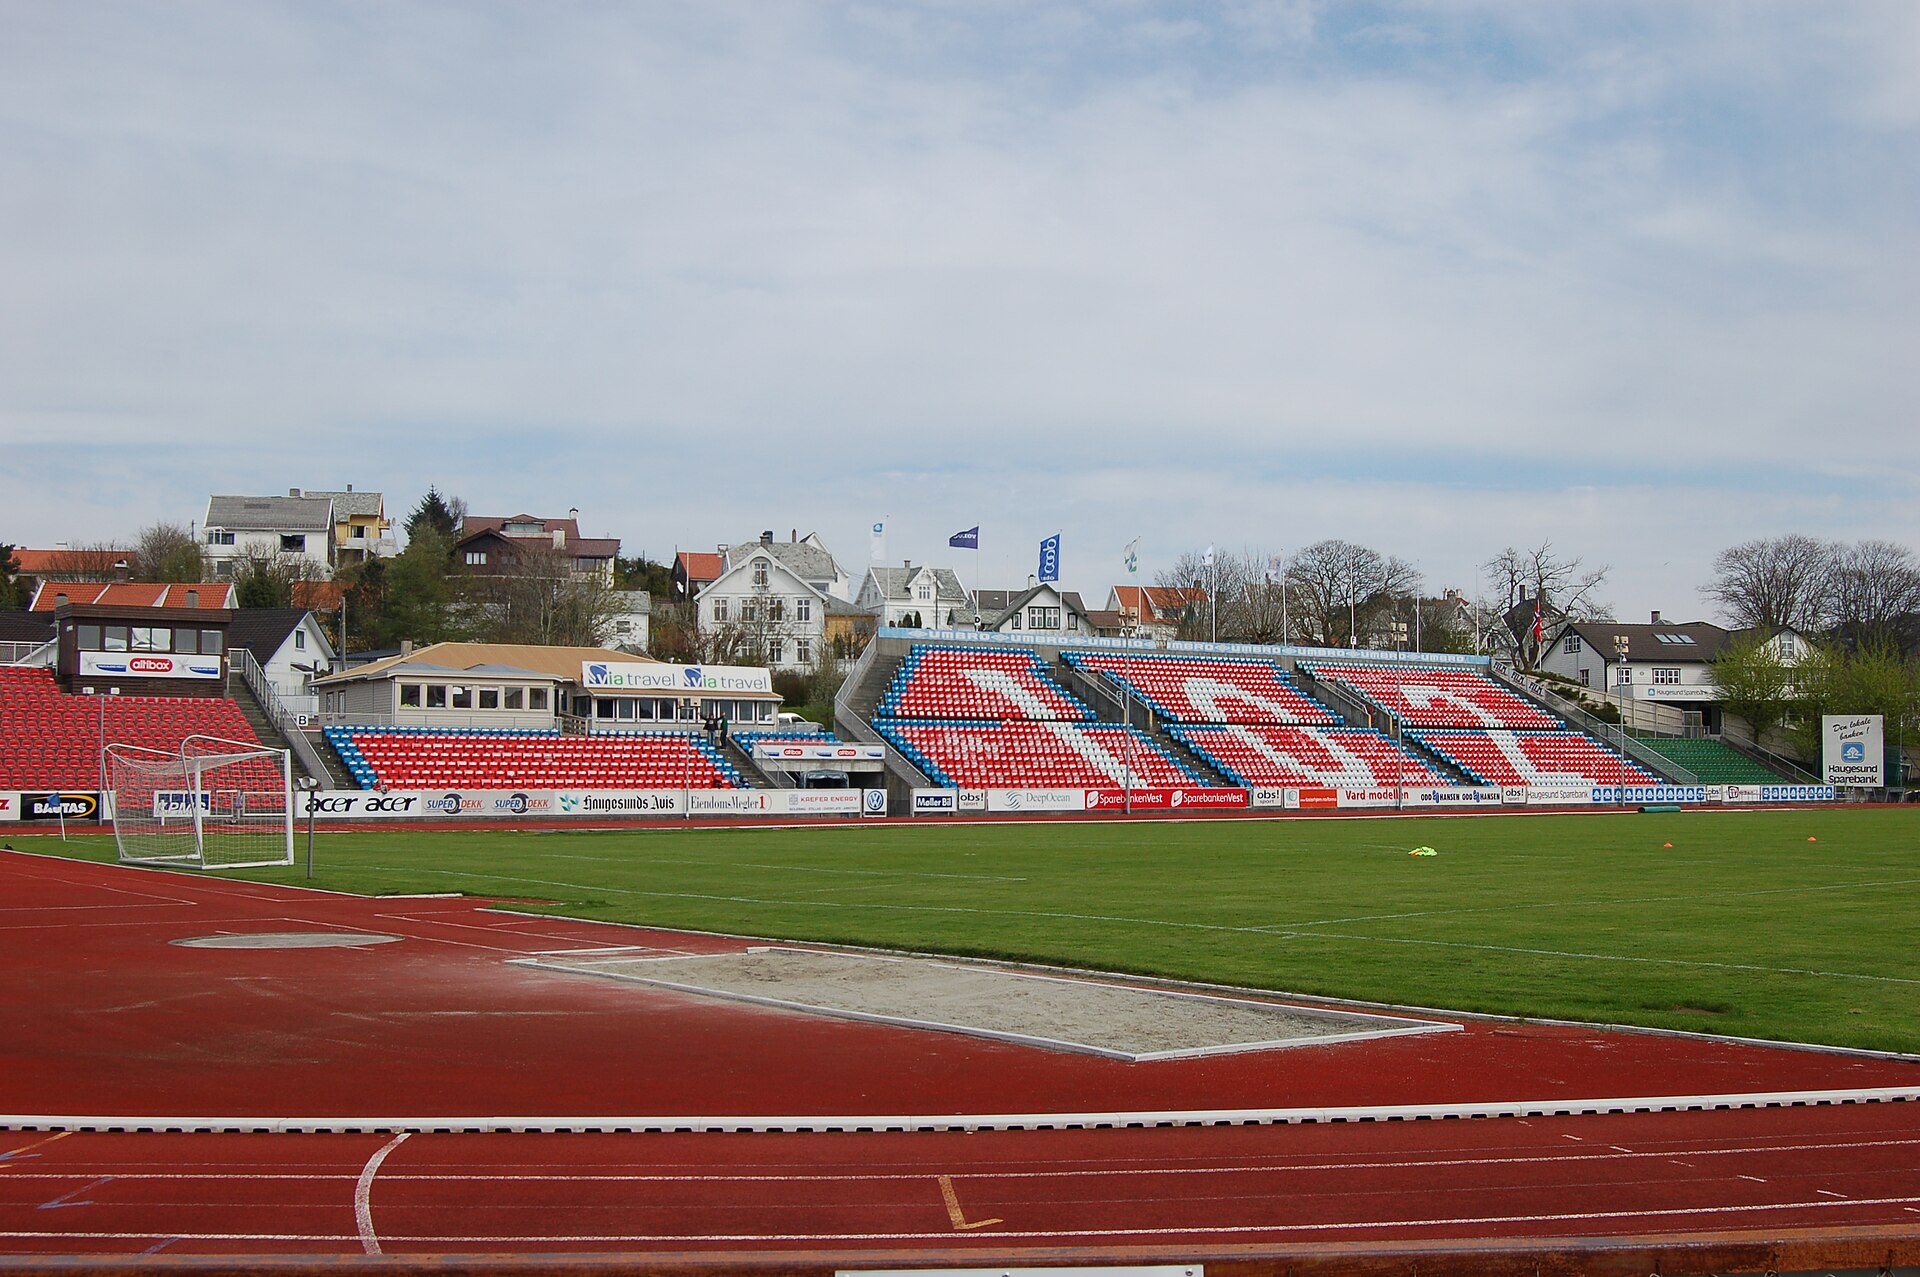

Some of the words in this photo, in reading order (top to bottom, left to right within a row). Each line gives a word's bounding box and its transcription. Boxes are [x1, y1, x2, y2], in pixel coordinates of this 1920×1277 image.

[928, 630, 991, 641] UMBRO
[1011, 634, 1068, 645] UMBRO
[132, 659, 170, 671] altibox
[627, 673, 676, 687] travel
[720, 676, 767, 690] travel
[298, 715, 307, 725] B
[1832, 723, 1848, 733] Den
[1850, 717, 1871, 728] lokale
[1828, 764, 1878, 774] Haugesund
[1828, 774, 1878, 785] Sparebank
[960, 792, 983, 801] obs!
[1257, 789, 1279, 799] obs!
[1345, 788, 1366, 800] Vard
[1440, 793, 1460, 801] HANSEN
[1505, 788, 1524, 797] obs!
[1527, 789, 1559, 800] Haugesund
[1560, 789, 1589, 800] Sparebank
[304, 796, 358, 813] acer
[364, 796, 417, 812] acer
[426, 799, 454, 809] SUPER
[460, 799, 483, 808] DEKK
[494, 799, 521, 809] SUPER
[527, 799, 549, 808] DEKK
[583, 794, 649, 812] Haugesunds
[650, 794, 675, 810] Avis
[830, 795, 858, 803] ENERGY
